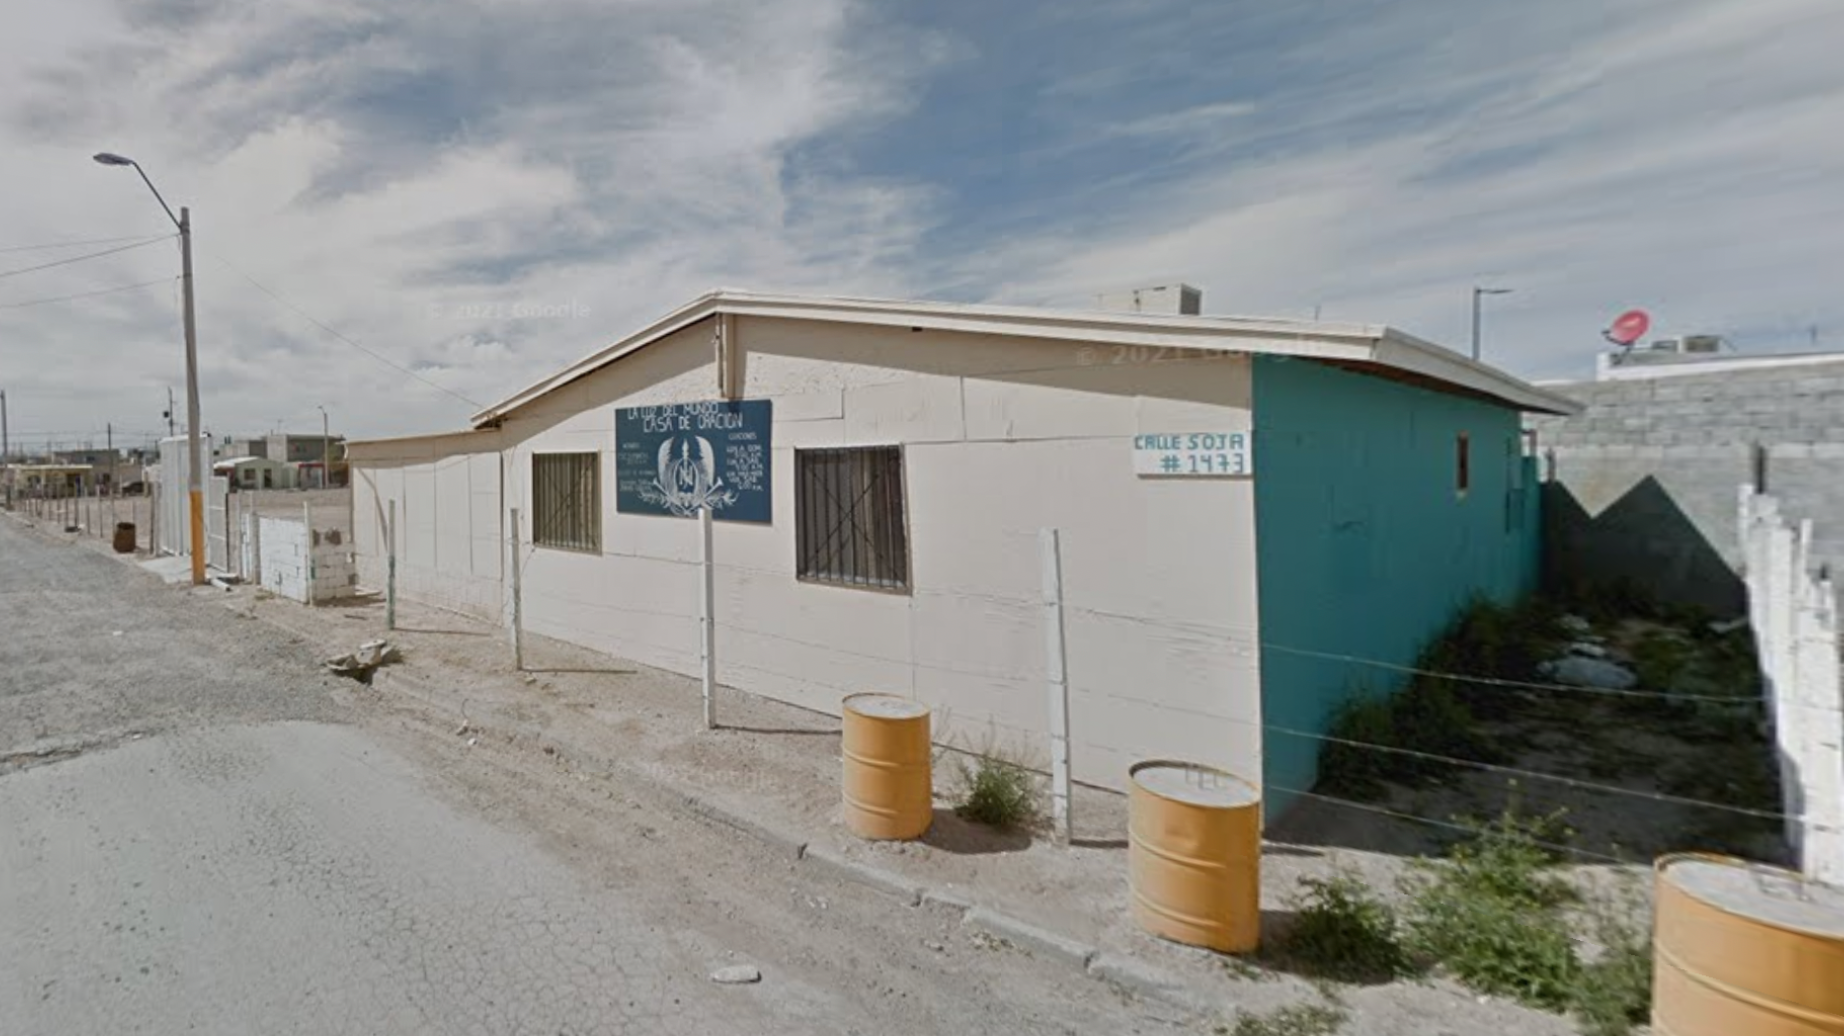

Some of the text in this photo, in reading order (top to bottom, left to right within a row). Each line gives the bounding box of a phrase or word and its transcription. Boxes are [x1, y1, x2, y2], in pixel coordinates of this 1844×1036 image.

[628, 401, 719, 419] LA LUZ DEL MUNDO
[643, 413, 743, 433] CASA DE ORACION
[1134, 433, 1244, 450] CALLE SOJA
[1160, 453, 1244, 473] # 1473
